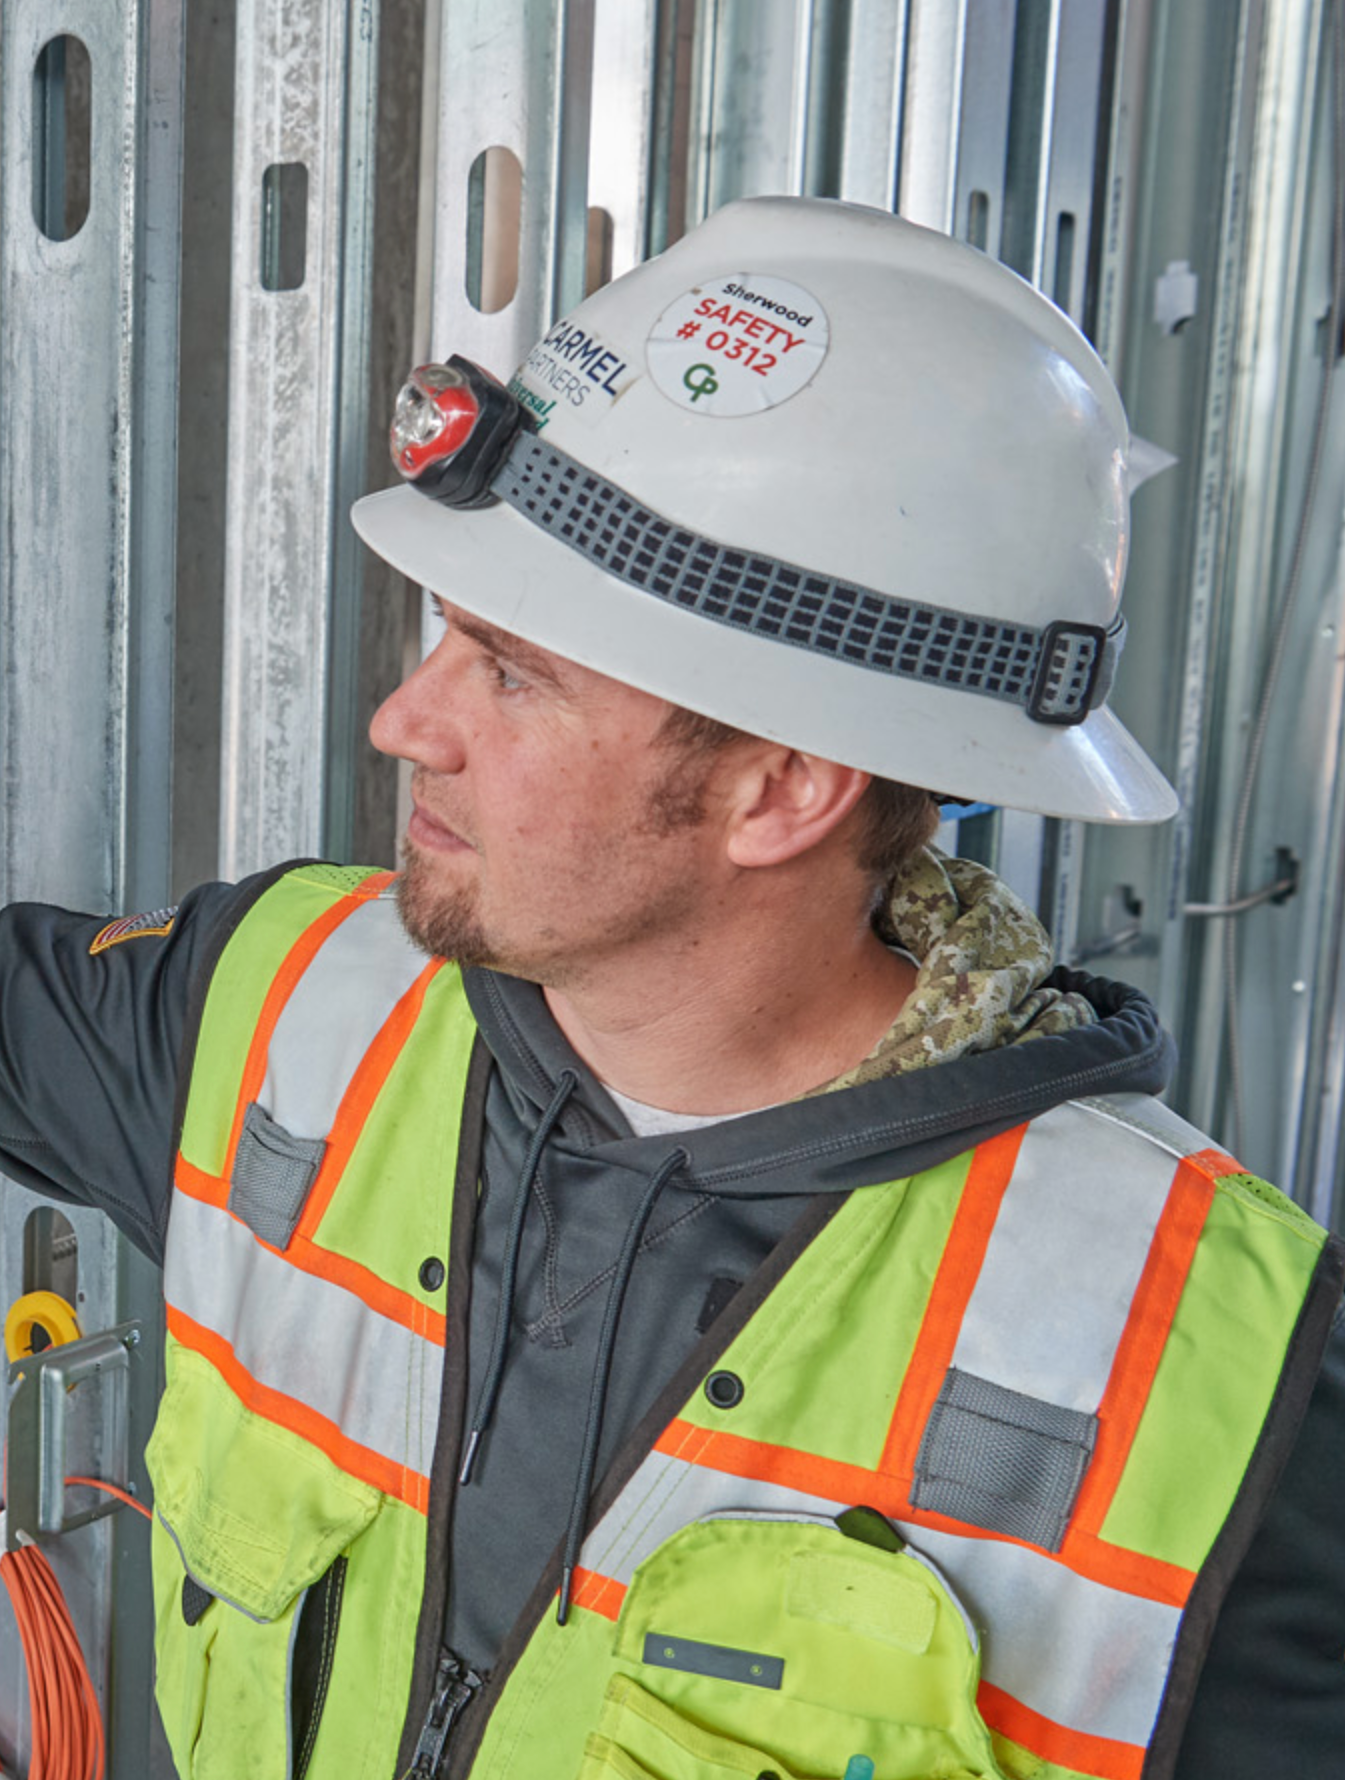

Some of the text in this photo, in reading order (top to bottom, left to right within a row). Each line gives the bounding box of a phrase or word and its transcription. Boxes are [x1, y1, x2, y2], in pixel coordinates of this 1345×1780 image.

[693, 297, 806, 354] SAFETY
[721, 282, 813, 328] Sherwood
[705, 329, 777, 377] 0312
